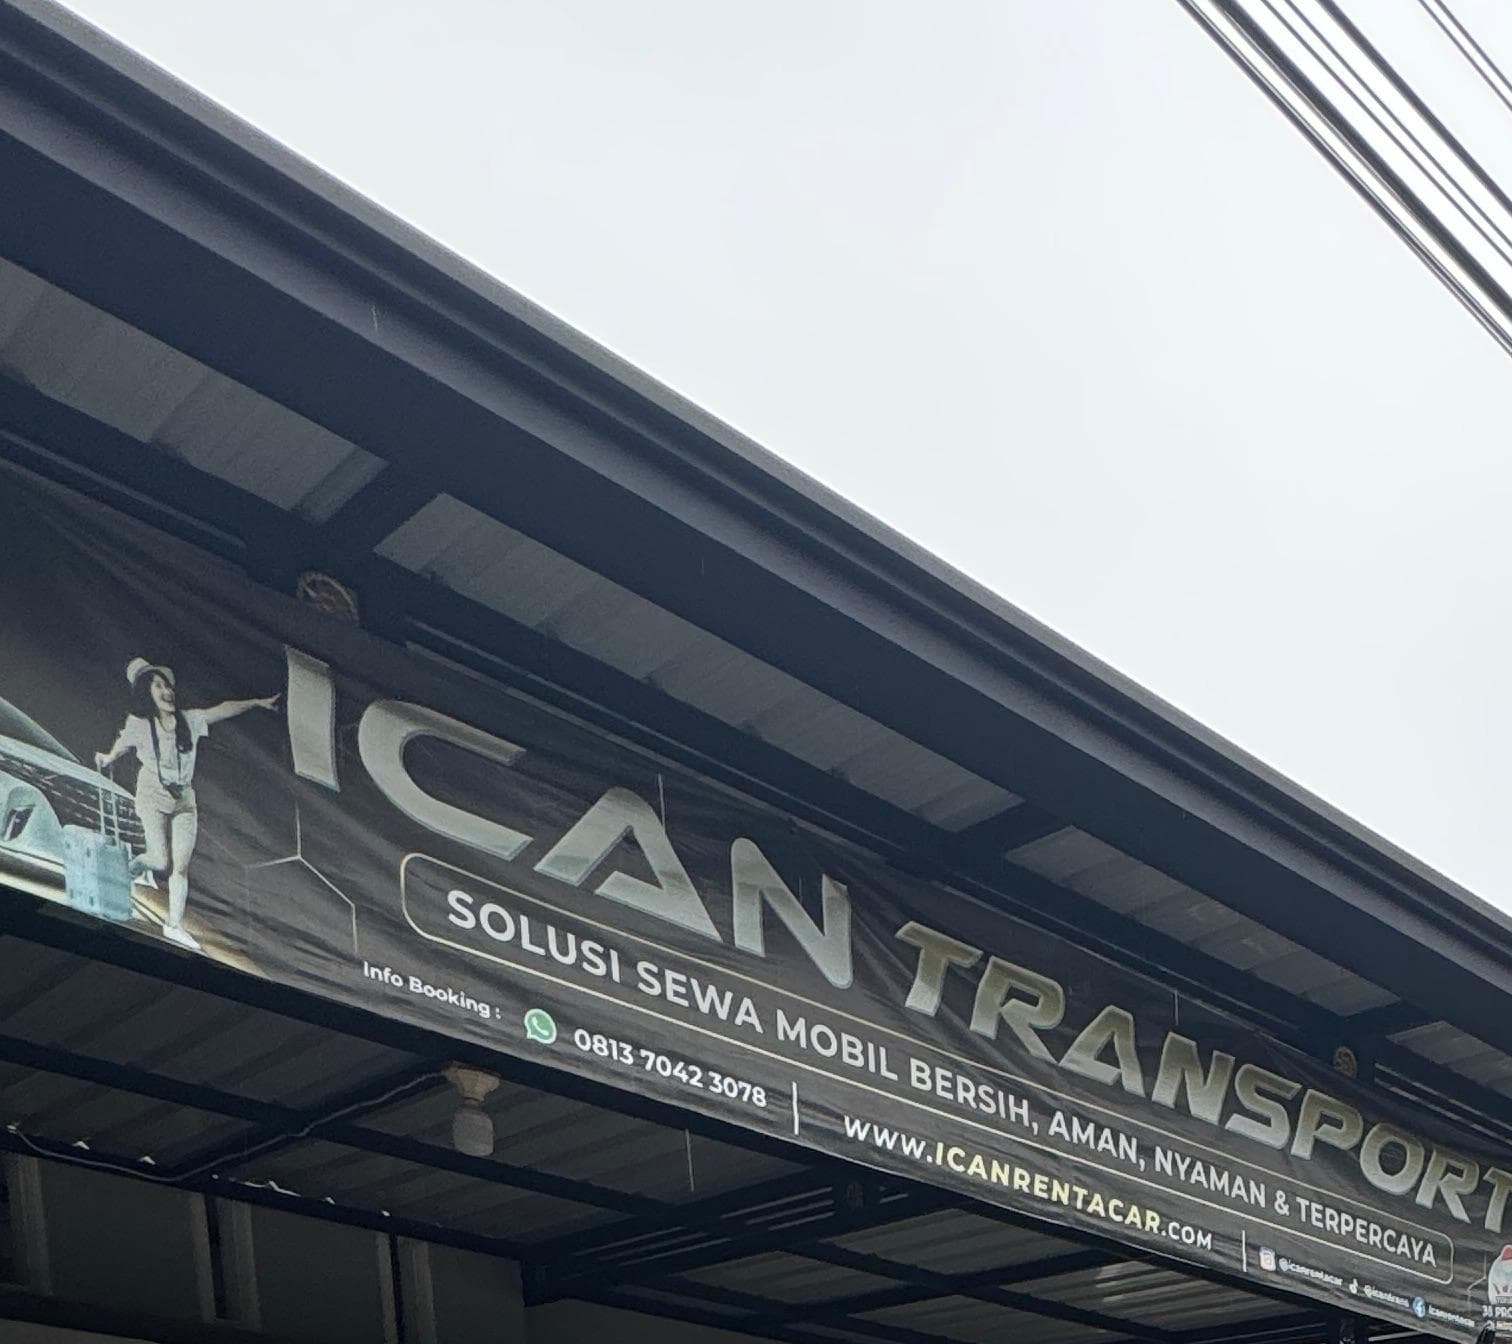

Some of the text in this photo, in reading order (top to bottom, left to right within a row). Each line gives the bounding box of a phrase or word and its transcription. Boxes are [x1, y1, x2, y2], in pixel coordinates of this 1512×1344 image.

[285, 645, 854, 990] ICAN
[363, 960, 404, 988] Info
[408, 974, 491, 1019] Booking
[446, 889, 1437, 1268] SOLUSI SEWA MOBIL BERSIH, AMAN, NYAMAN & TERPERCAYA
[573, 1028, 768, 1108] 0813 7042 3078
[843, 1114, 1213, 1254] WWW.ICANRENTACAR.COM
